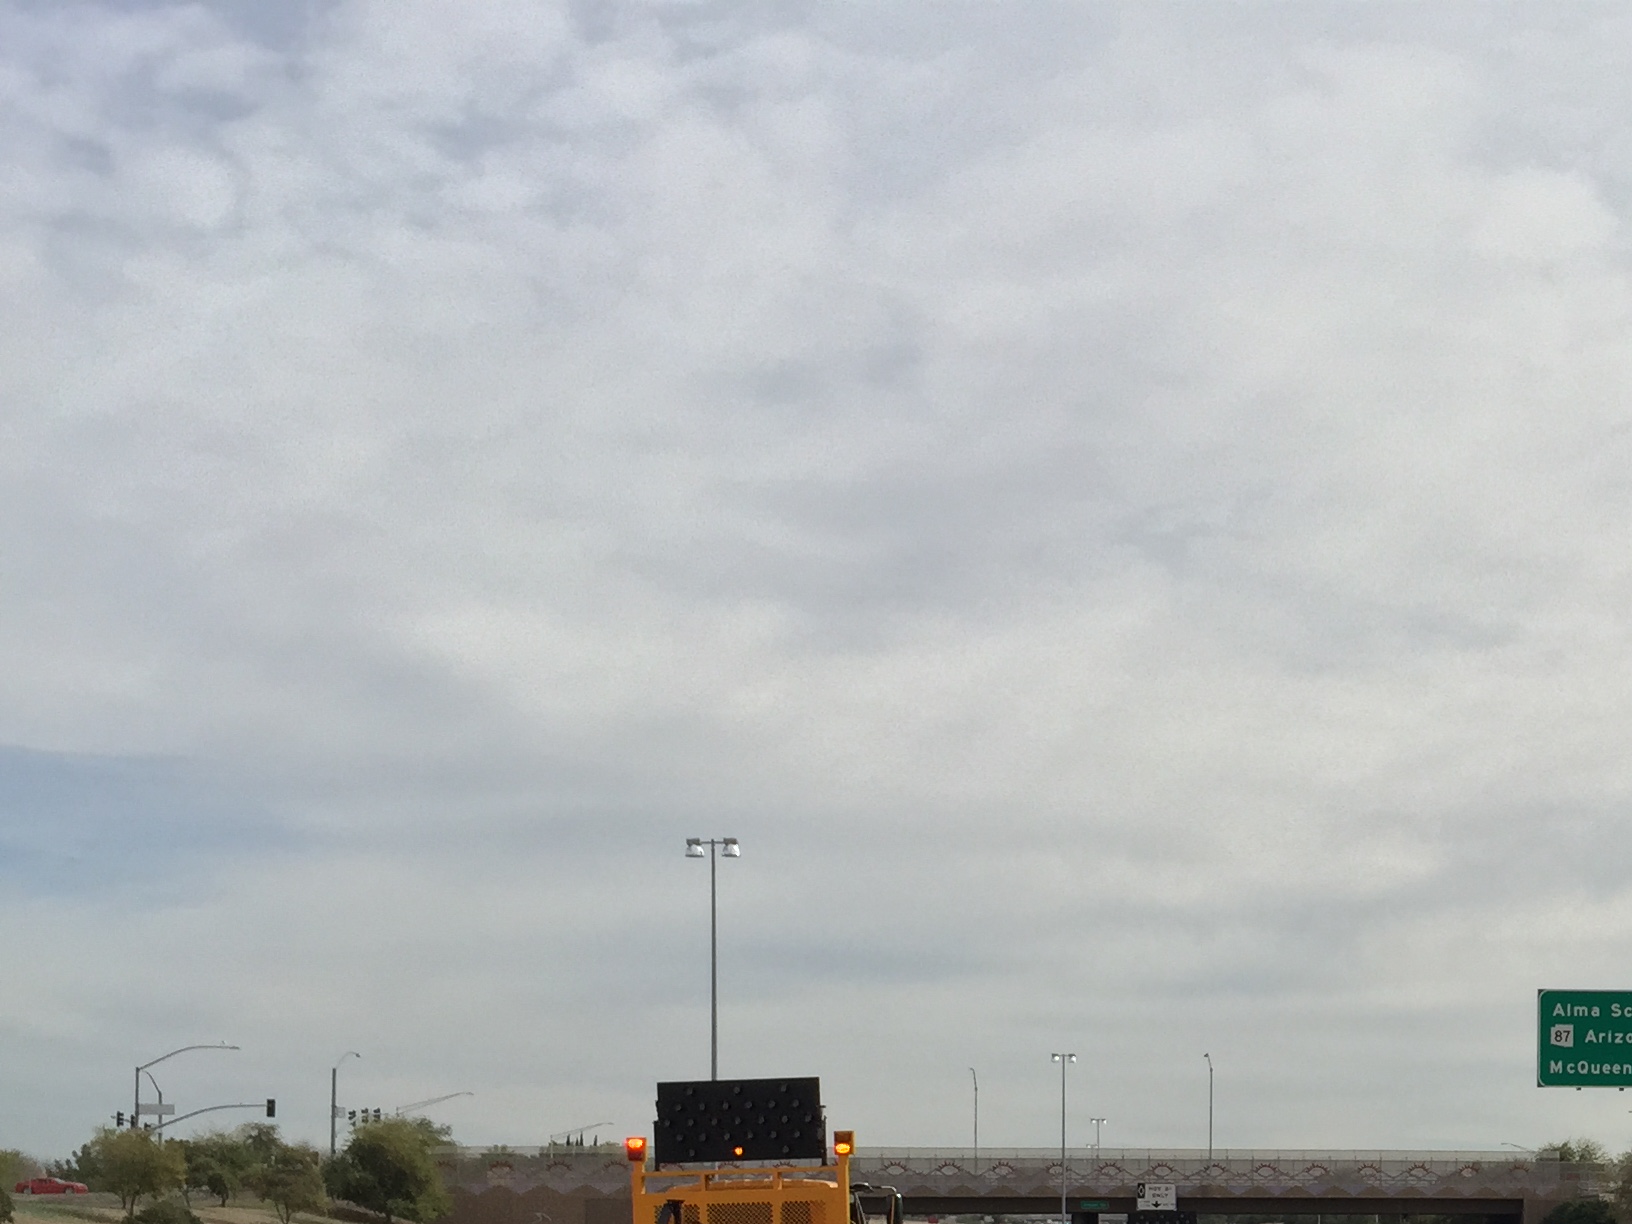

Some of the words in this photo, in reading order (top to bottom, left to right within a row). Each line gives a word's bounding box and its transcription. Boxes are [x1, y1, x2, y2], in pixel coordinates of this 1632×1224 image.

[1553, 1003, 1600, 1017] Alma
[1554, 1030, 1571, 1043] 87
[1550, 1060, 1632, 1075] McQueen
